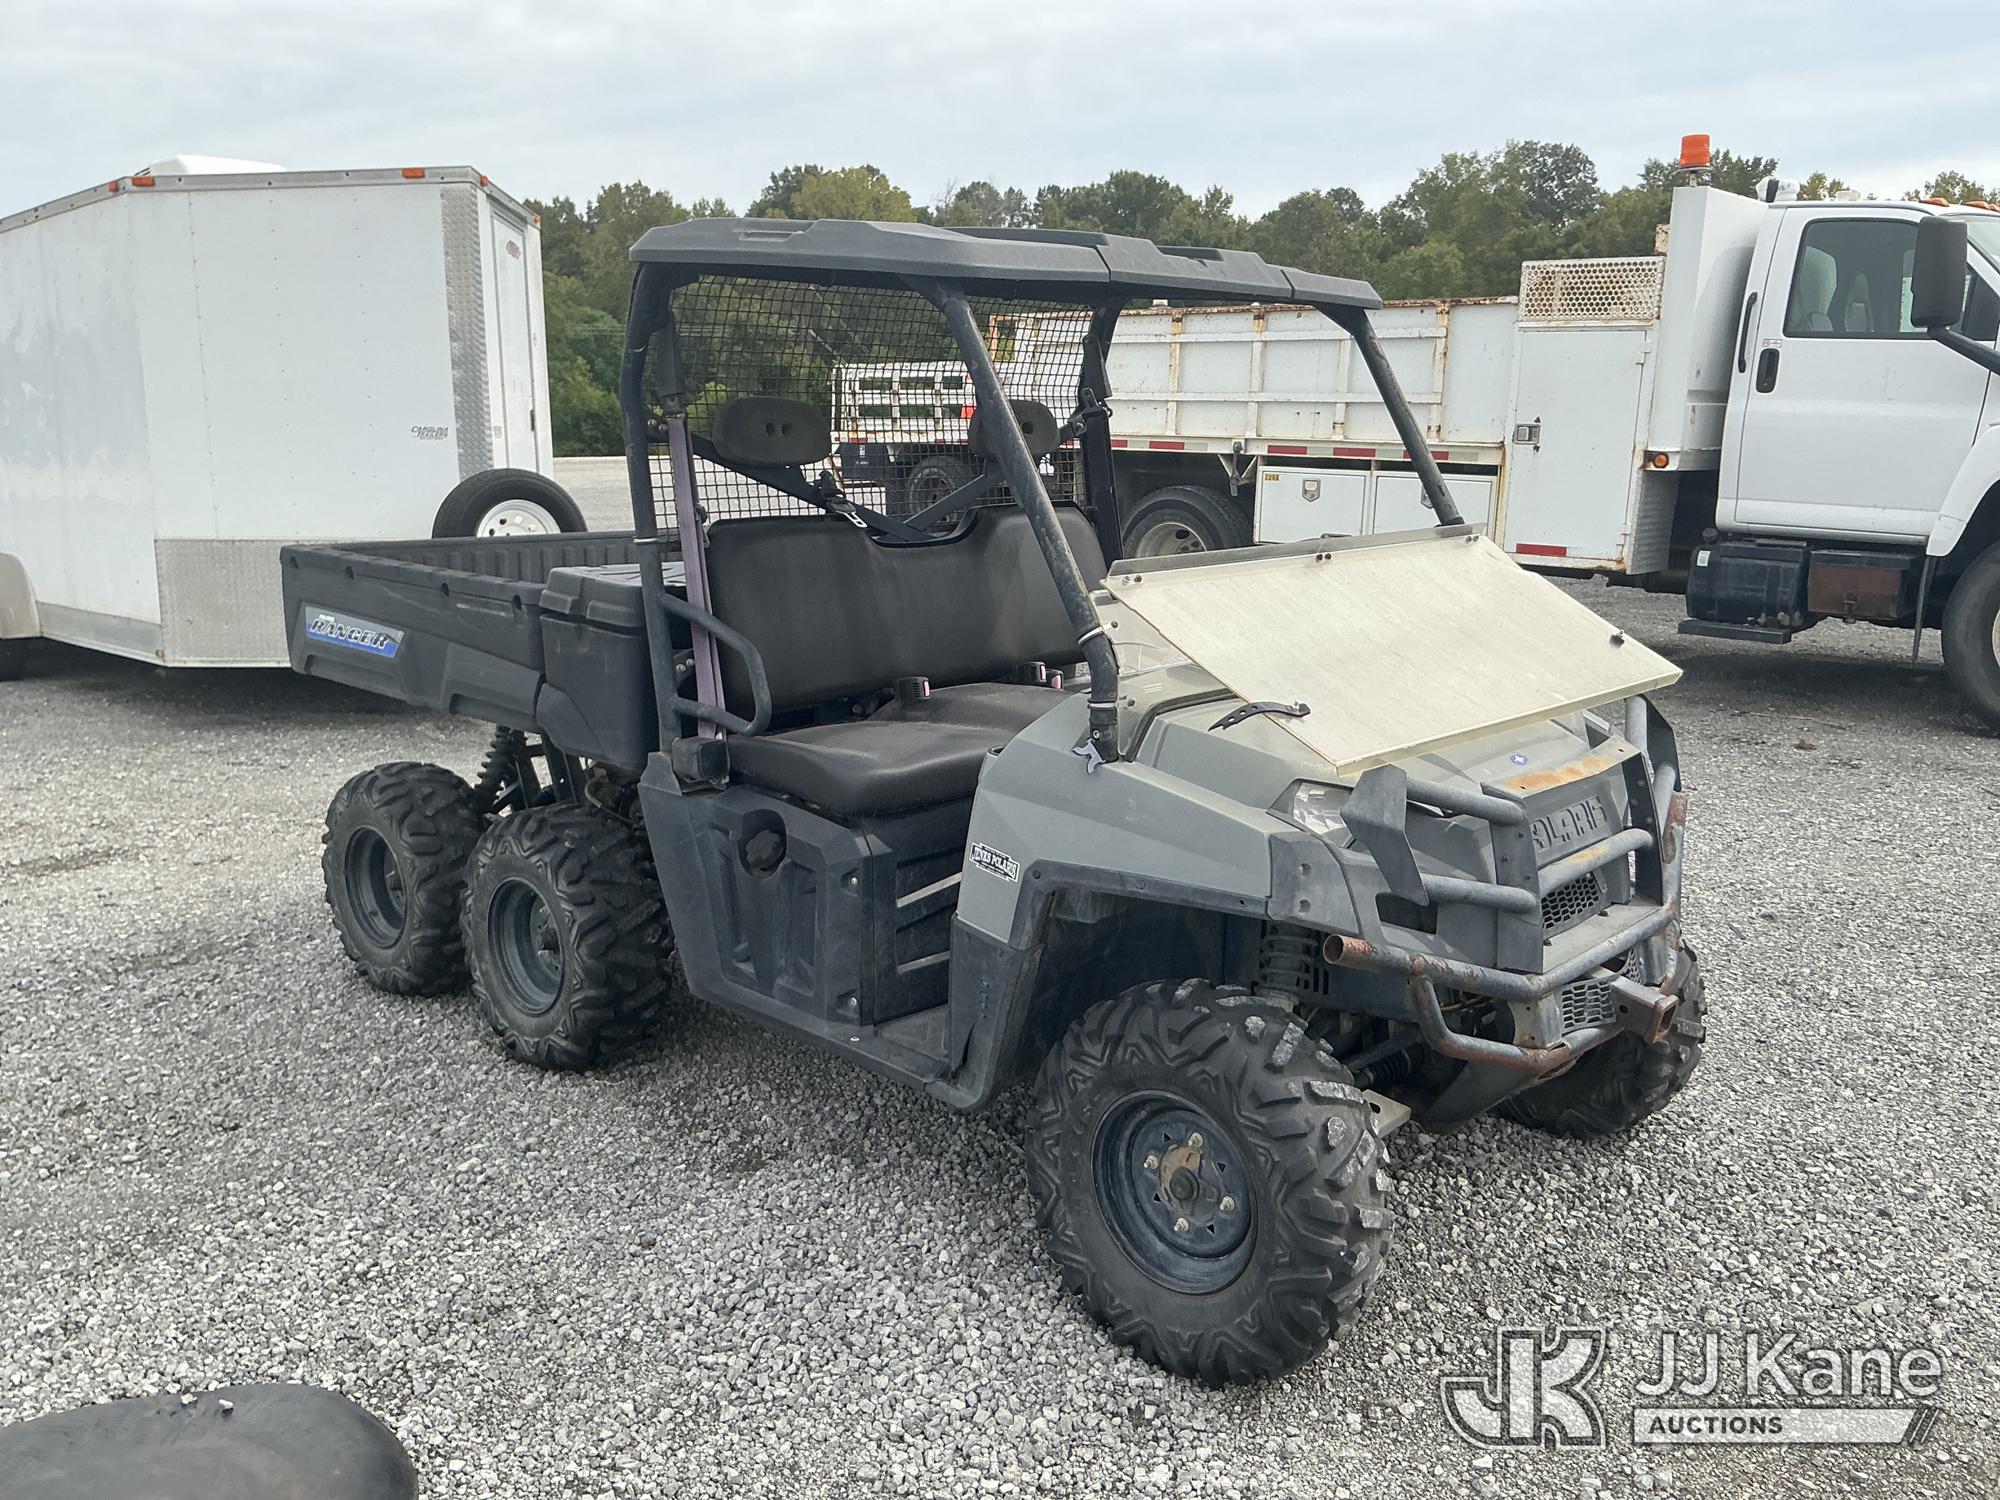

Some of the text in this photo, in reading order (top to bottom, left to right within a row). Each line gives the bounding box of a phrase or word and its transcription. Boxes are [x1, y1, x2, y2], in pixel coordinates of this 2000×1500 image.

[309, 618, 389, 650] RANGER
[1530, 795, 1608, 852] OLARIS
[991, 854, 1016, 879] POLARIS
